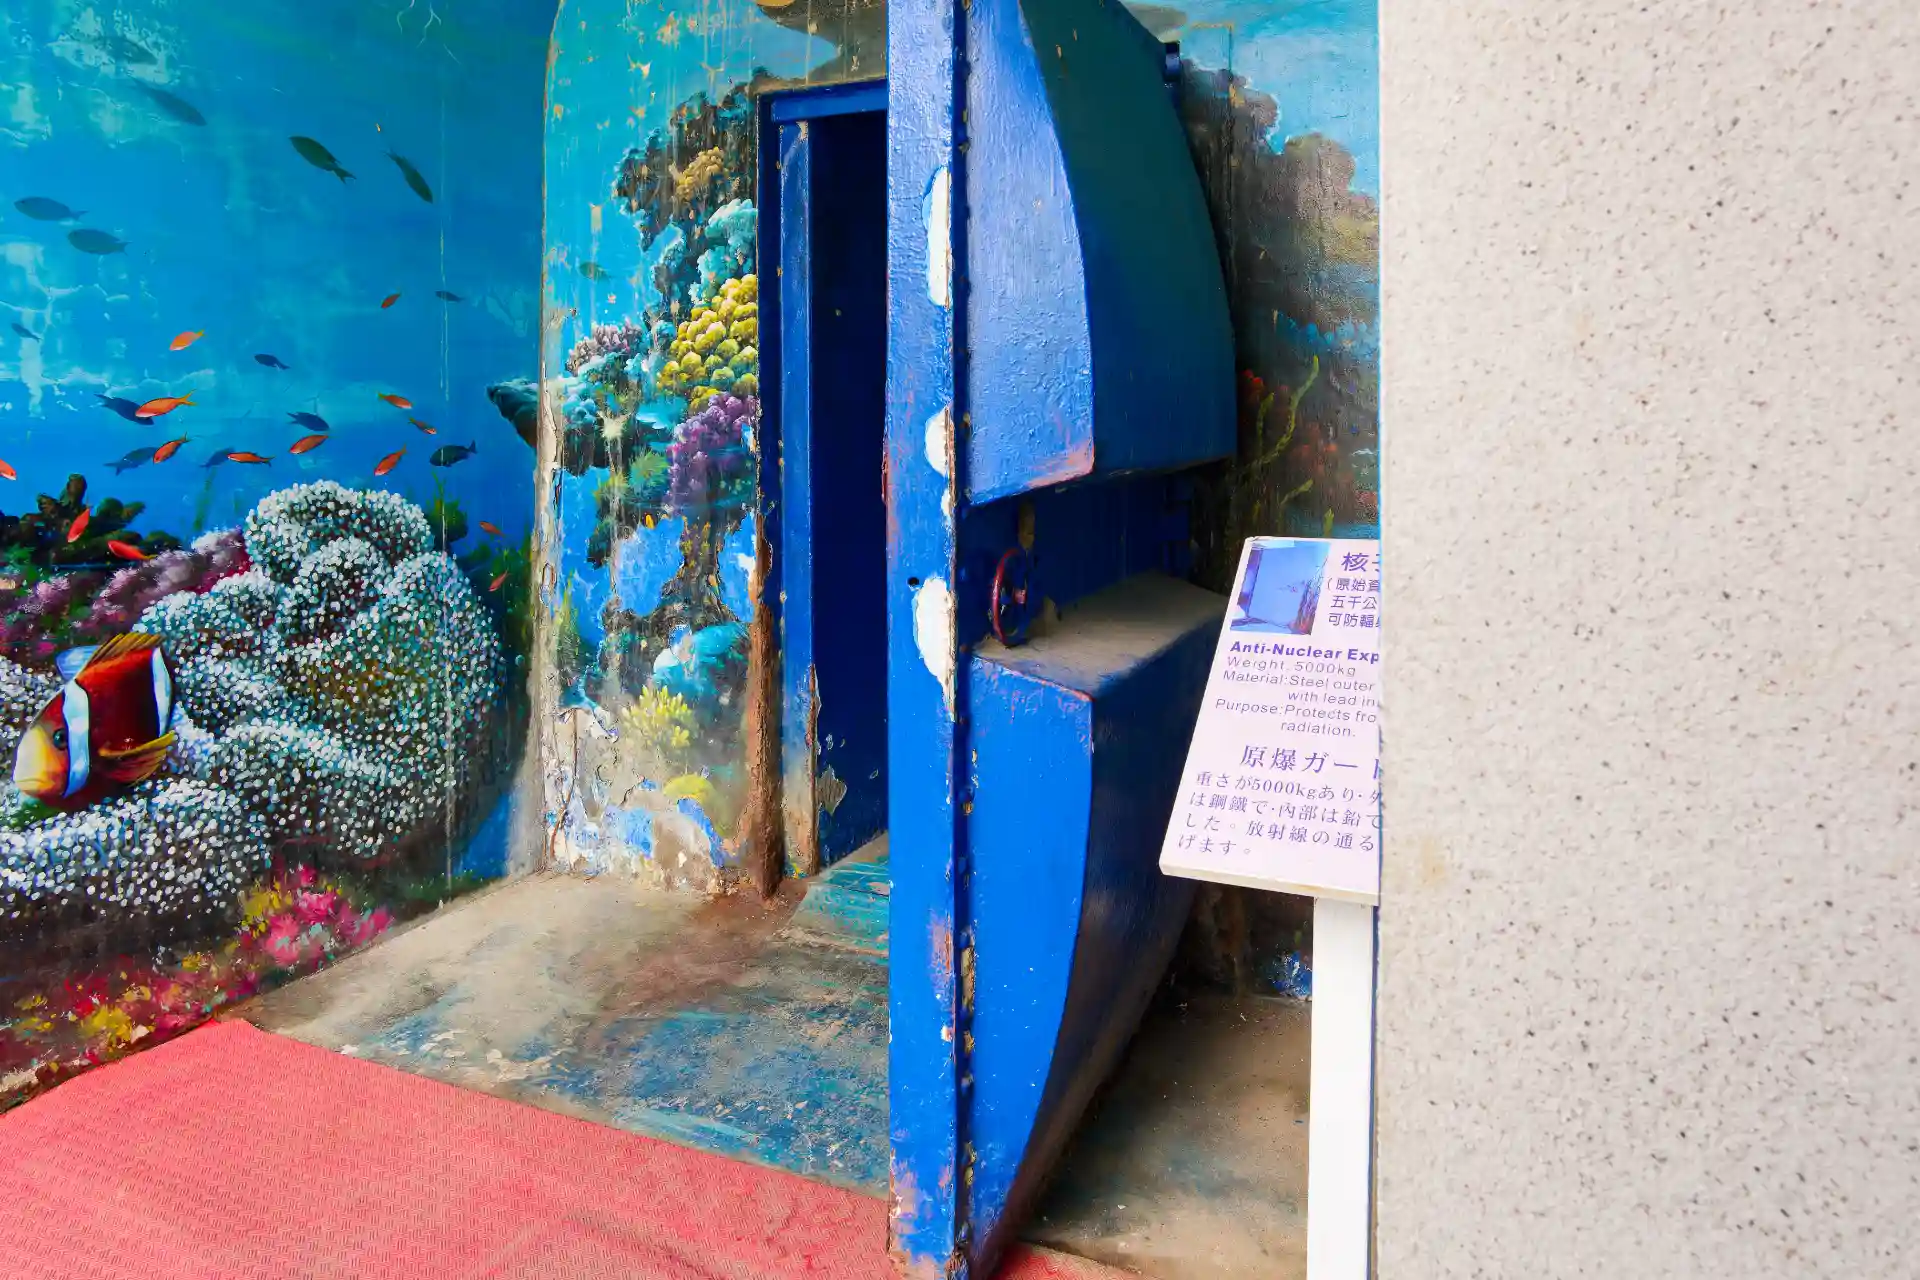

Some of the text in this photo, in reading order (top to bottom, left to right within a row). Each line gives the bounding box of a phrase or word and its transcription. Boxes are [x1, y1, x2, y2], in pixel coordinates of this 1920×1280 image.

[1330, 595, 1378, 610] 五千公
[1230, 641, 1343, 660] Anti-Nuclear
[1333, 681, 1374, 691] outer
[1288, 692, 1318, 702] with
[1323, 694, 1357, 706] lead
[1281, 721, 1356, 737] radiation.
